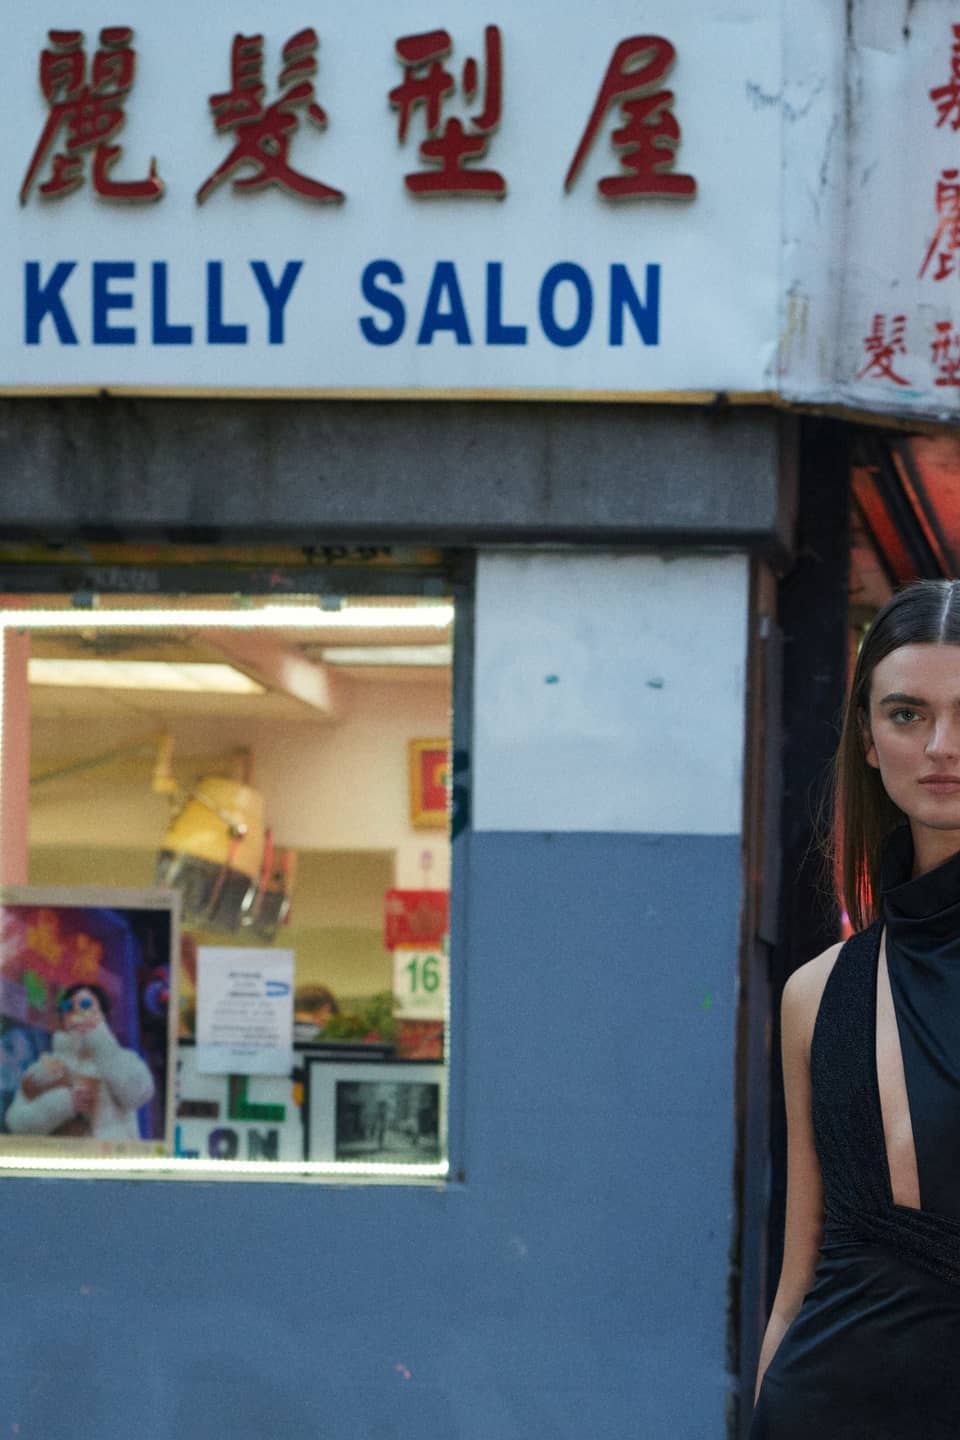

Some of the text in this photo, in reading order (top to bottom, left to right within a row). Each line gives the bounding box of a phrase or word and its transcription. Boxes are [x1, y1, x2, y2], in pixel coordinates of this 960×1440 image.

[20, 24, 697, 206] 麗髮型屋
[24, 260, 661, 346] KELLY SALON
[406, 956, 440, 993] 16
